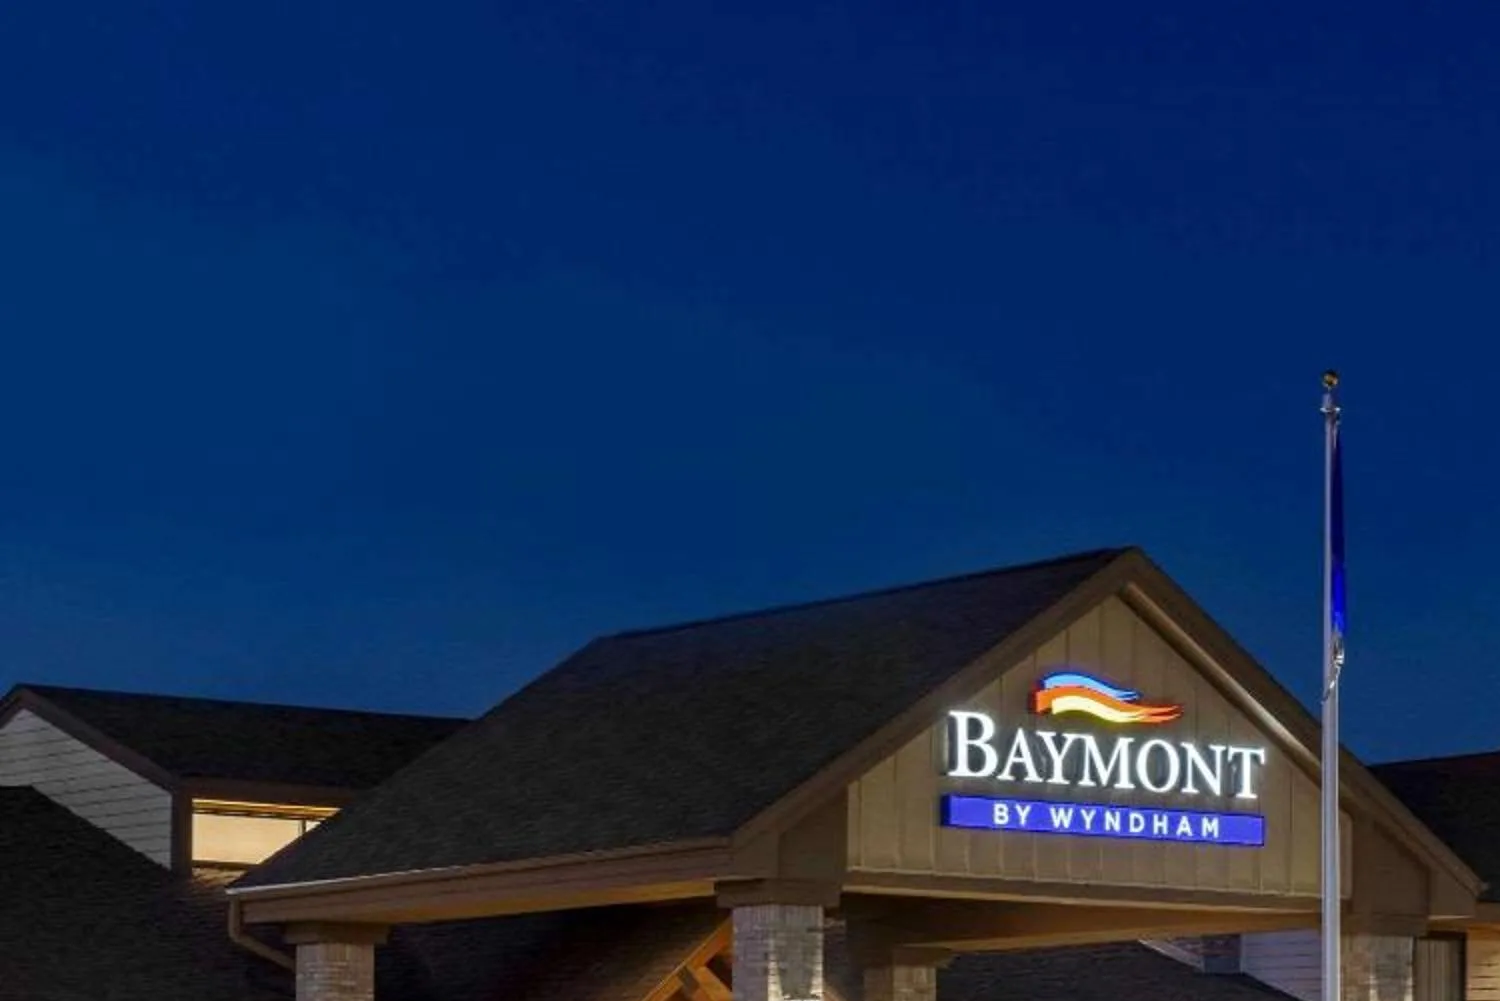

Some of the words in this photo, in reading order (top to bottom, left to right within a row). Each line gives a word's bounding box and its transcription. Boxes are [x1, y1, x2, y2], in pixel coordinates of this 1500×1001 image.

[948, 709, 1265, 799] BAYMONT
[993, 803, 1034, 826] BY
[1049, 807, 1220, 838] WYNDHAM
